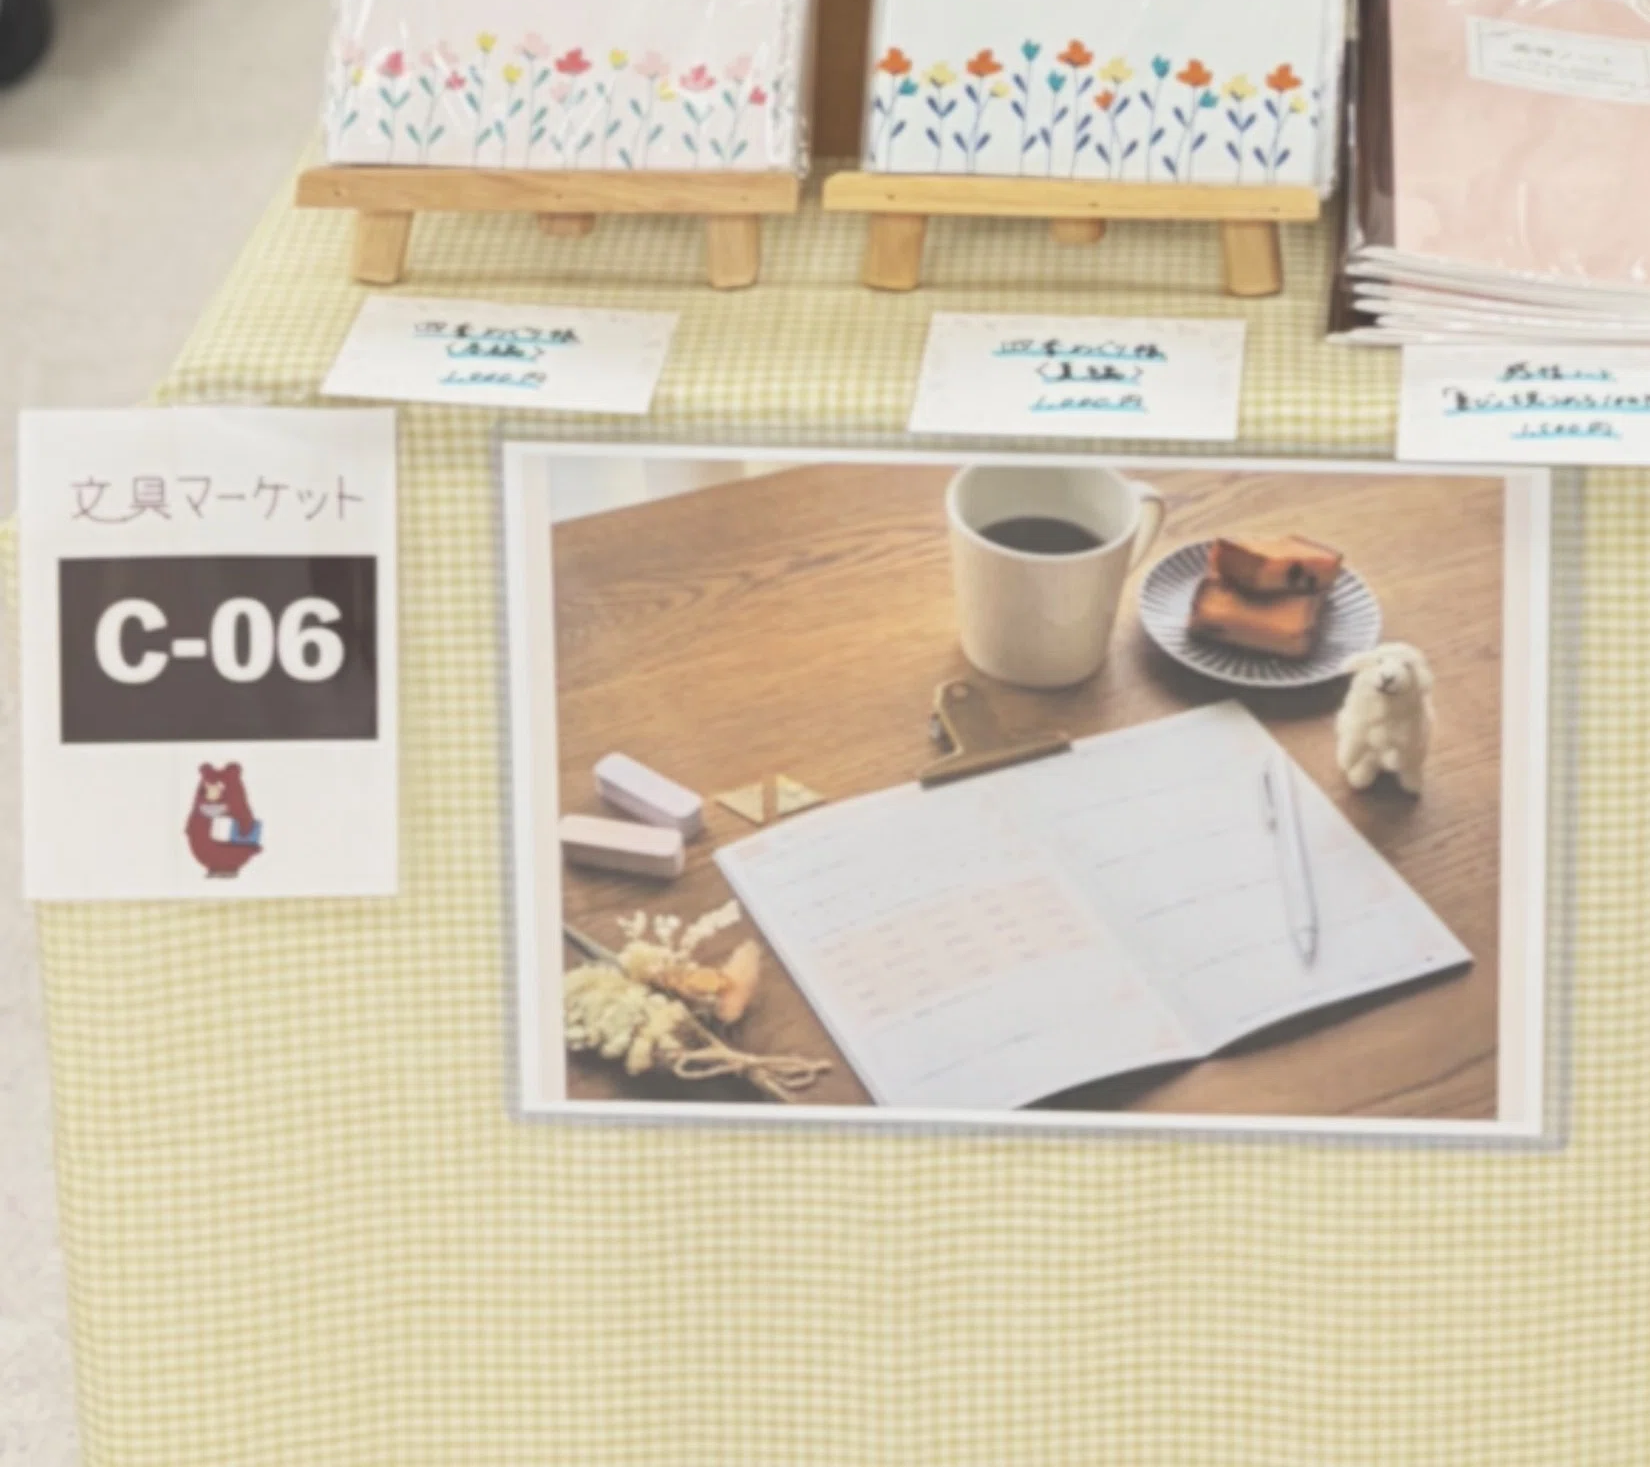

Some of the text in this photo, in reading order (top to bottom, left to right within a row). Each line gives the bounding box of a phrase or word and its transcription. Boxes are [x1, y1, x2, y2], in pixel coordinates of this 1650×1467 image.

[70, 475, 364, 524] 文具マーケット
[94, 596, 345, 684] C-06
